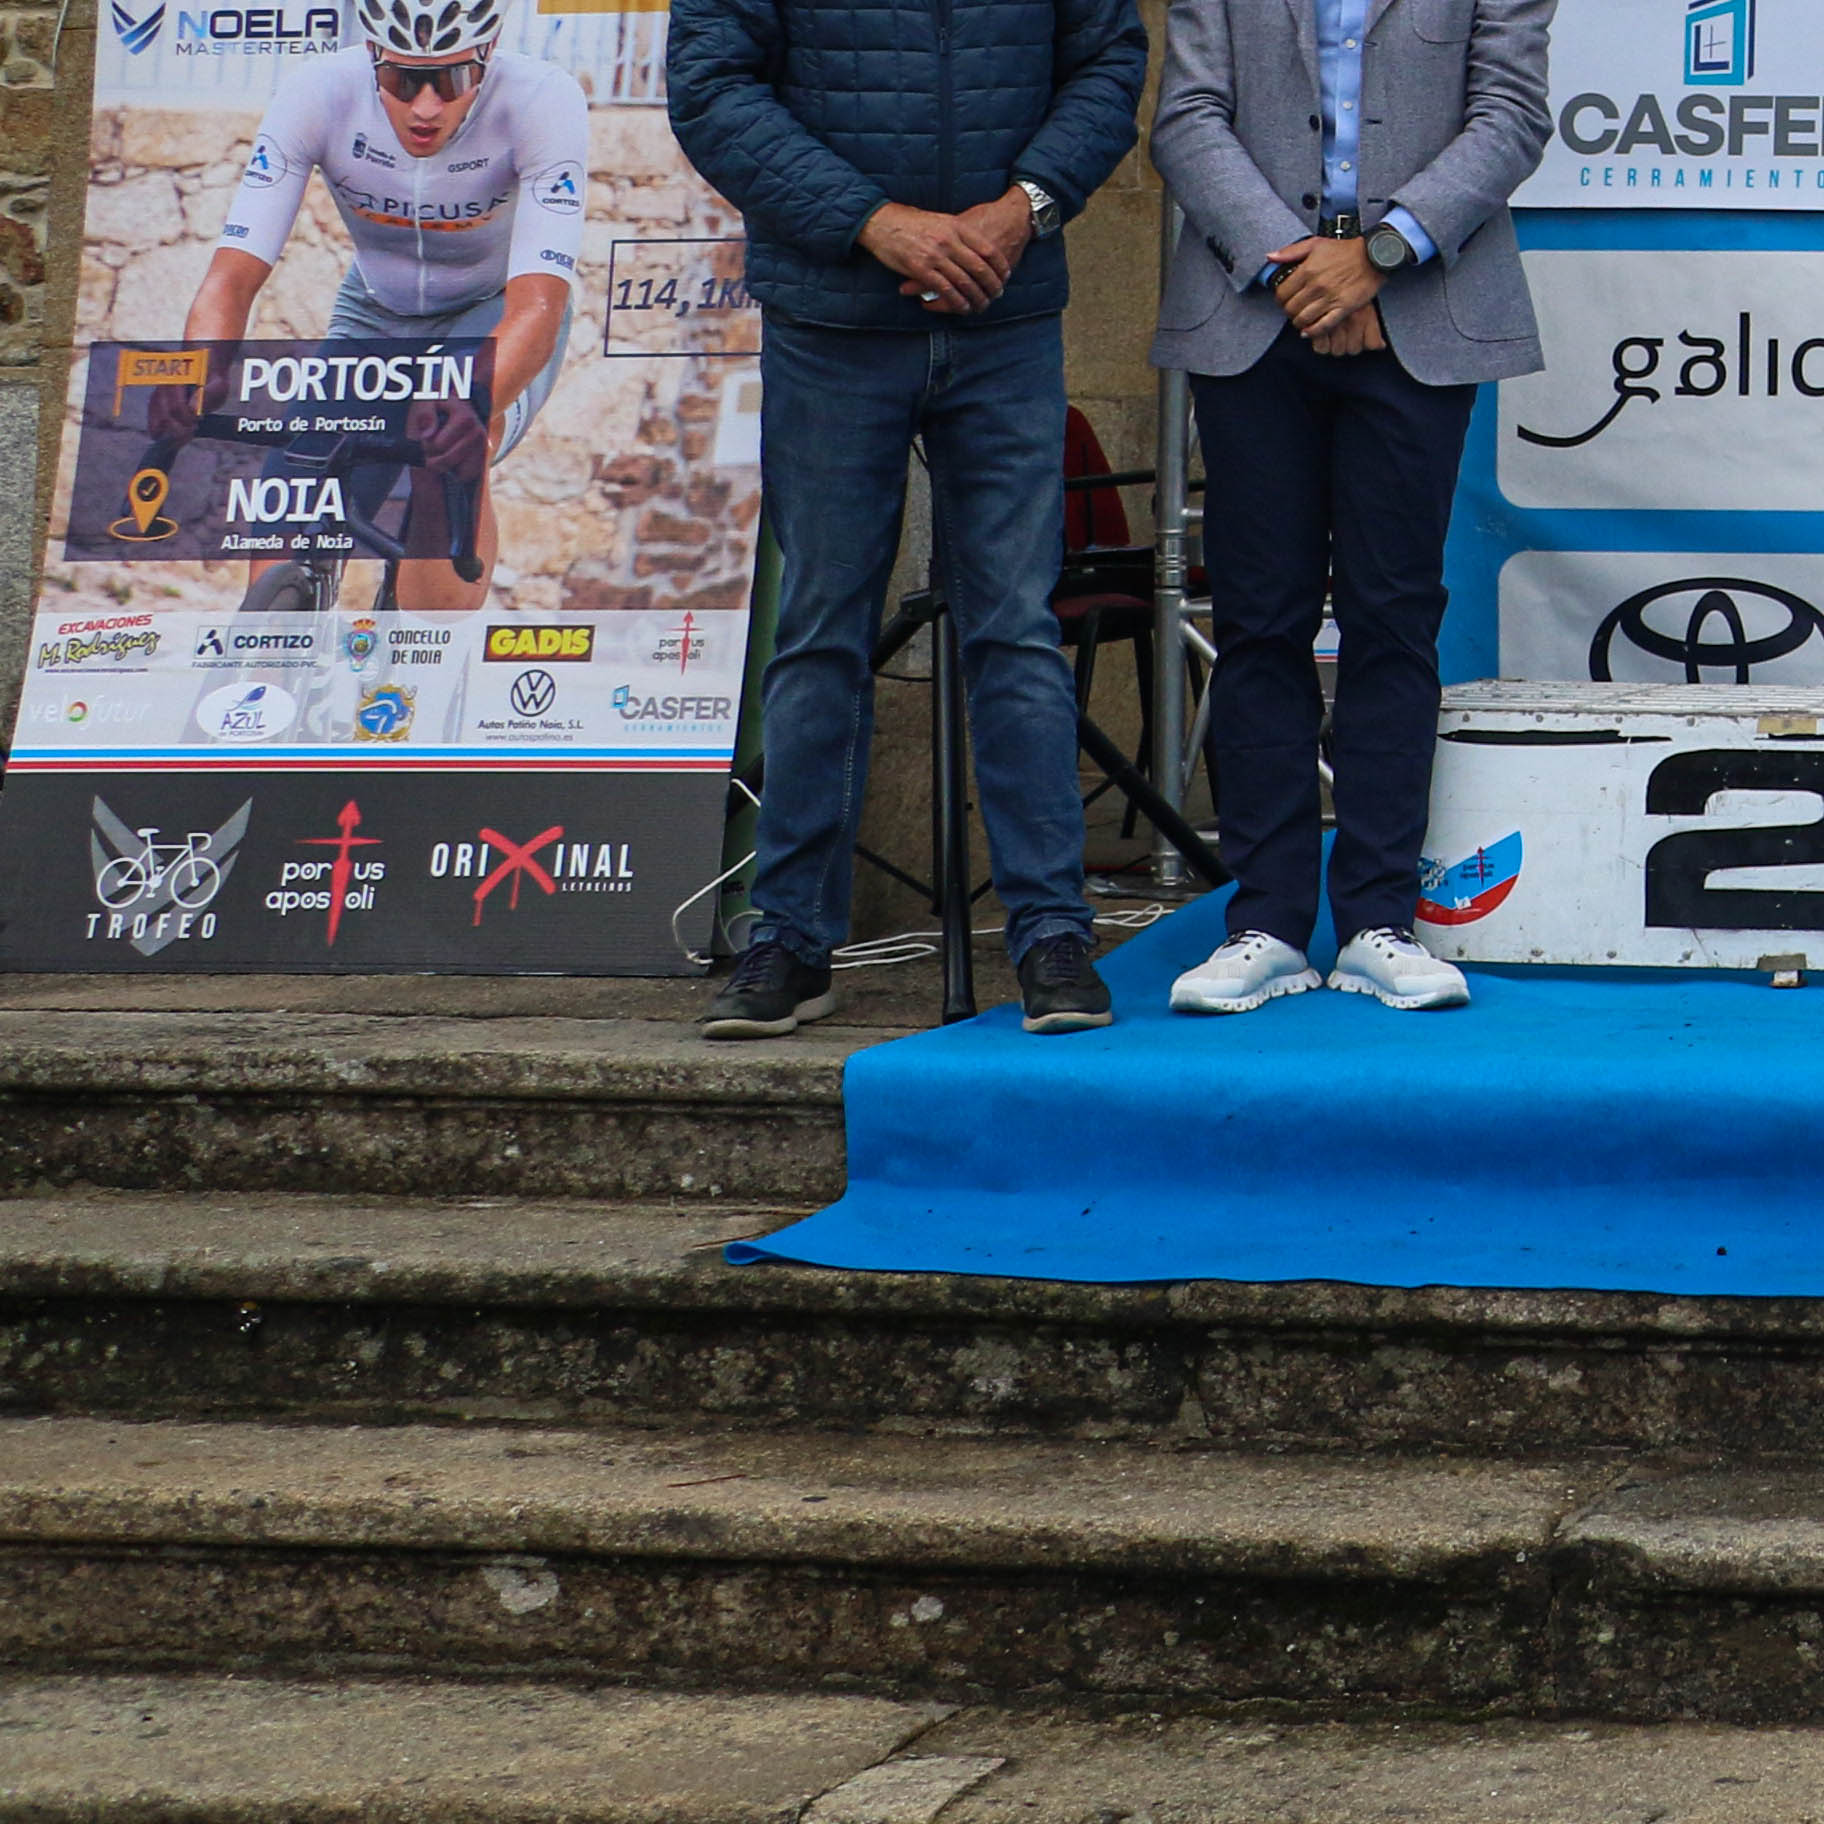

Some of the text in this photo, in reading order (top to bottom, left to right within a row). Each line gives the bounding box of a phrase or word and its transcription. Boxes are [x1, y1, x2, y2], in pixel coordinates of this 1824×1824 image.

[178, 7, 338, 39] NOELA
[176, 41, 338, 56] MASTERTEAM
[132, 357, 195, 378] START
[240, 346, 473, 402] PORTOSÍN
[238, 416, 385, 433] Porto de Portosín
[226, 478, 345, 523] NOIA
[221, 535, 353, 551] Alameda de Noia
[58, 614, 153, 635] EXCAVACIONES
[234, 635, 313, 649] CORTIZO
[389, 630, 451, 645] CONCELLO
[489, 628, 593, 658] GADIS
[392, 650, 408, 664] DE
[620, 696, 731, 720] CASFER
[477, 720, 503, 730] Autos
[87, 913, 217, 939] TROFEO
